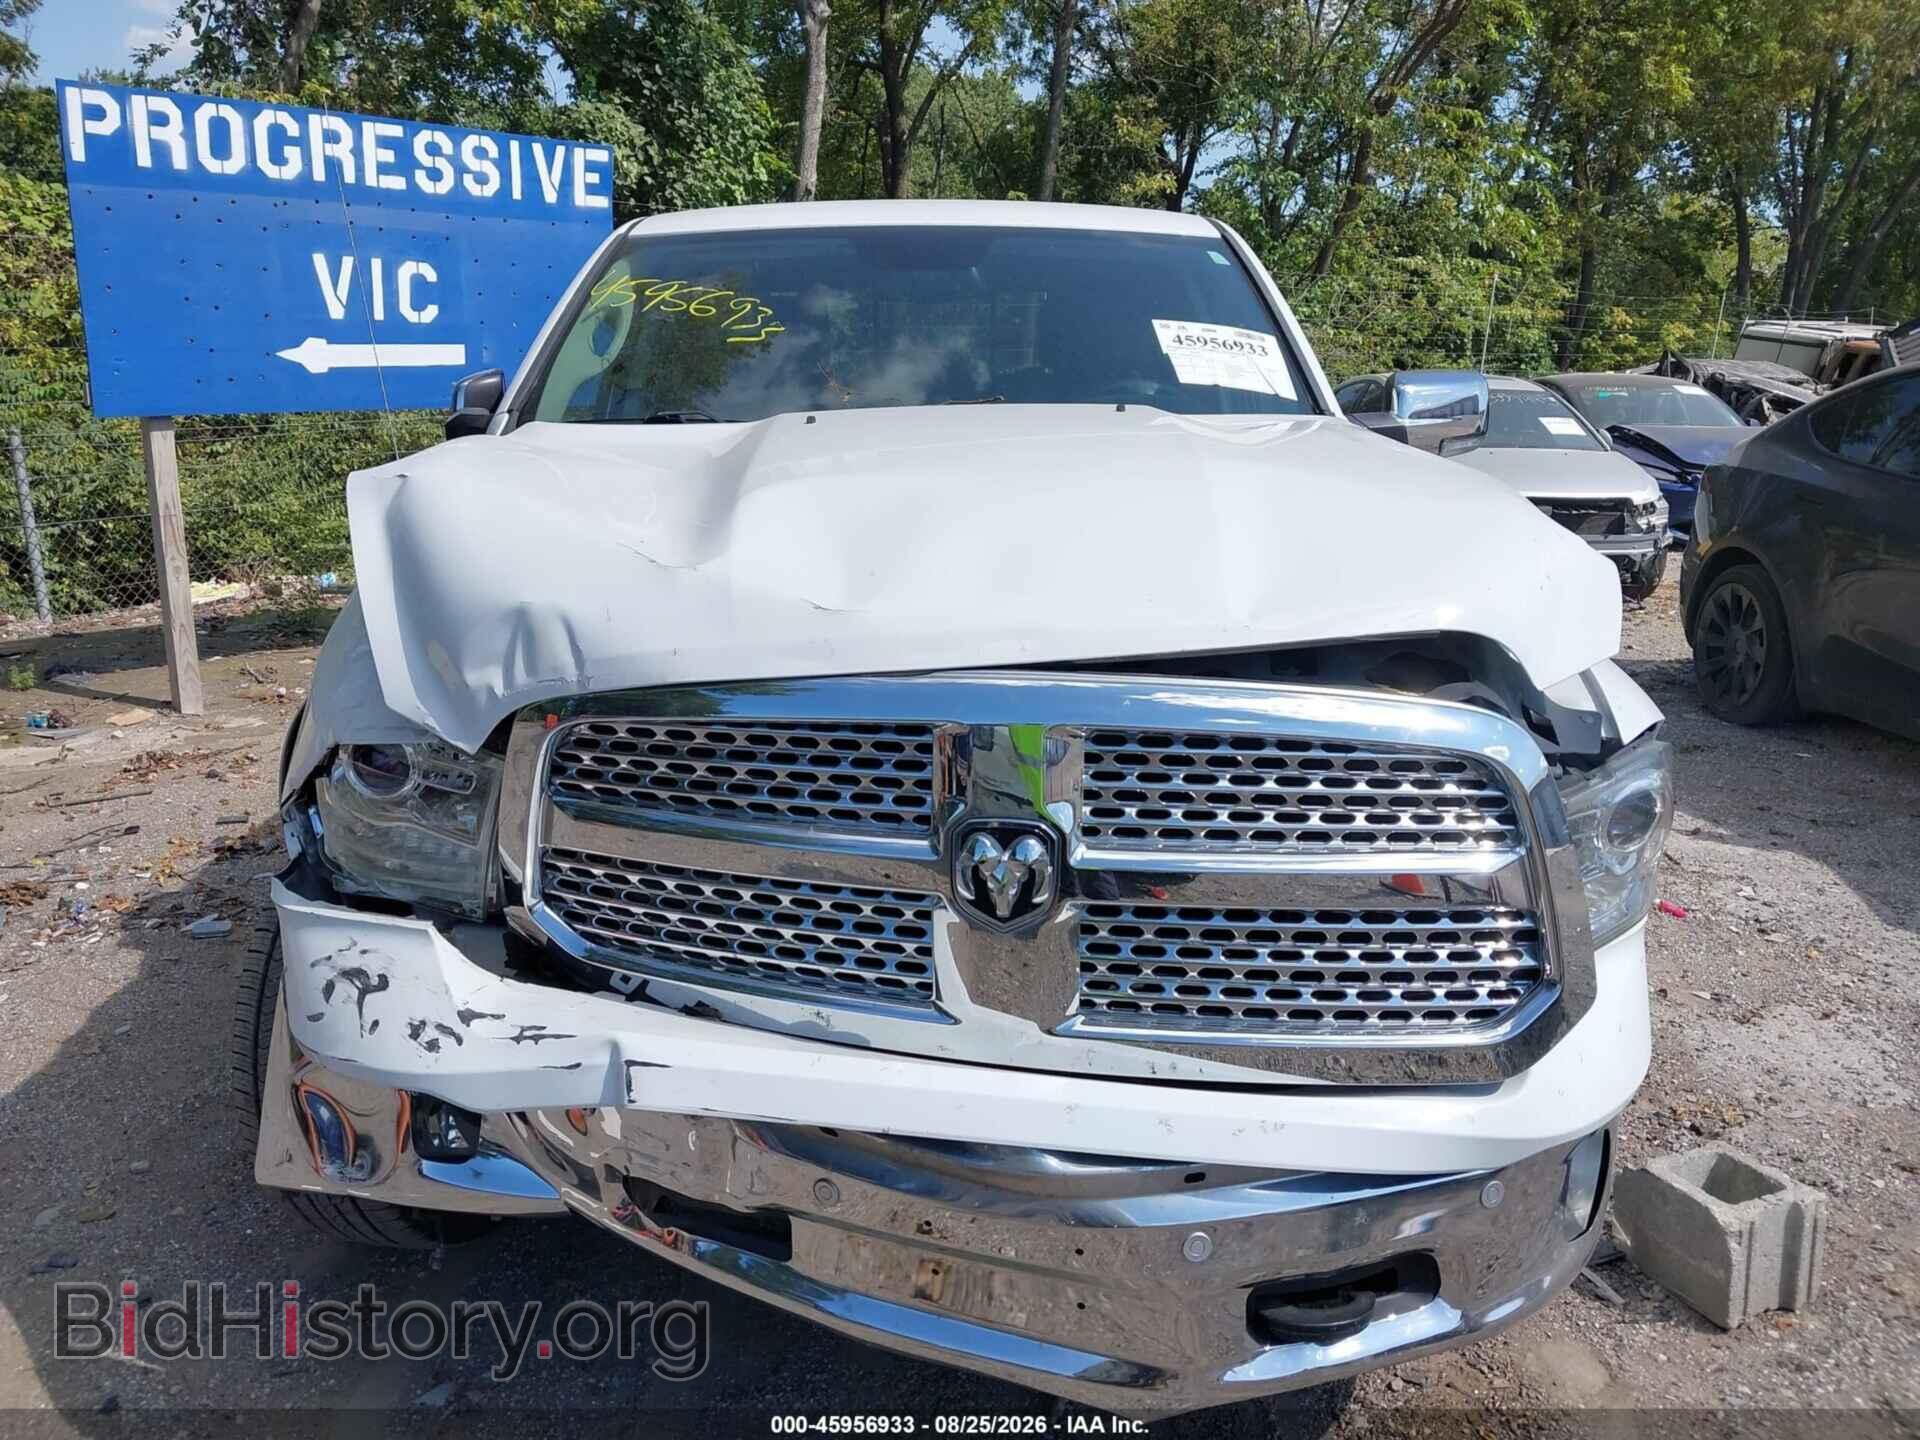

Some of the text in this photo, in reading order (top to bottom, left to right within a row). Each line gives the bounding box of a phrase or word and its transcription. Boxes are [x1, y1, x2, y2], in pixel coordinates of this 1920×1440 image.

[65, 86, 610, 208] PROGRESSIVE
[312, 253, 439, 323] VIC
[1172, 334, 1269, 357] 45956933
